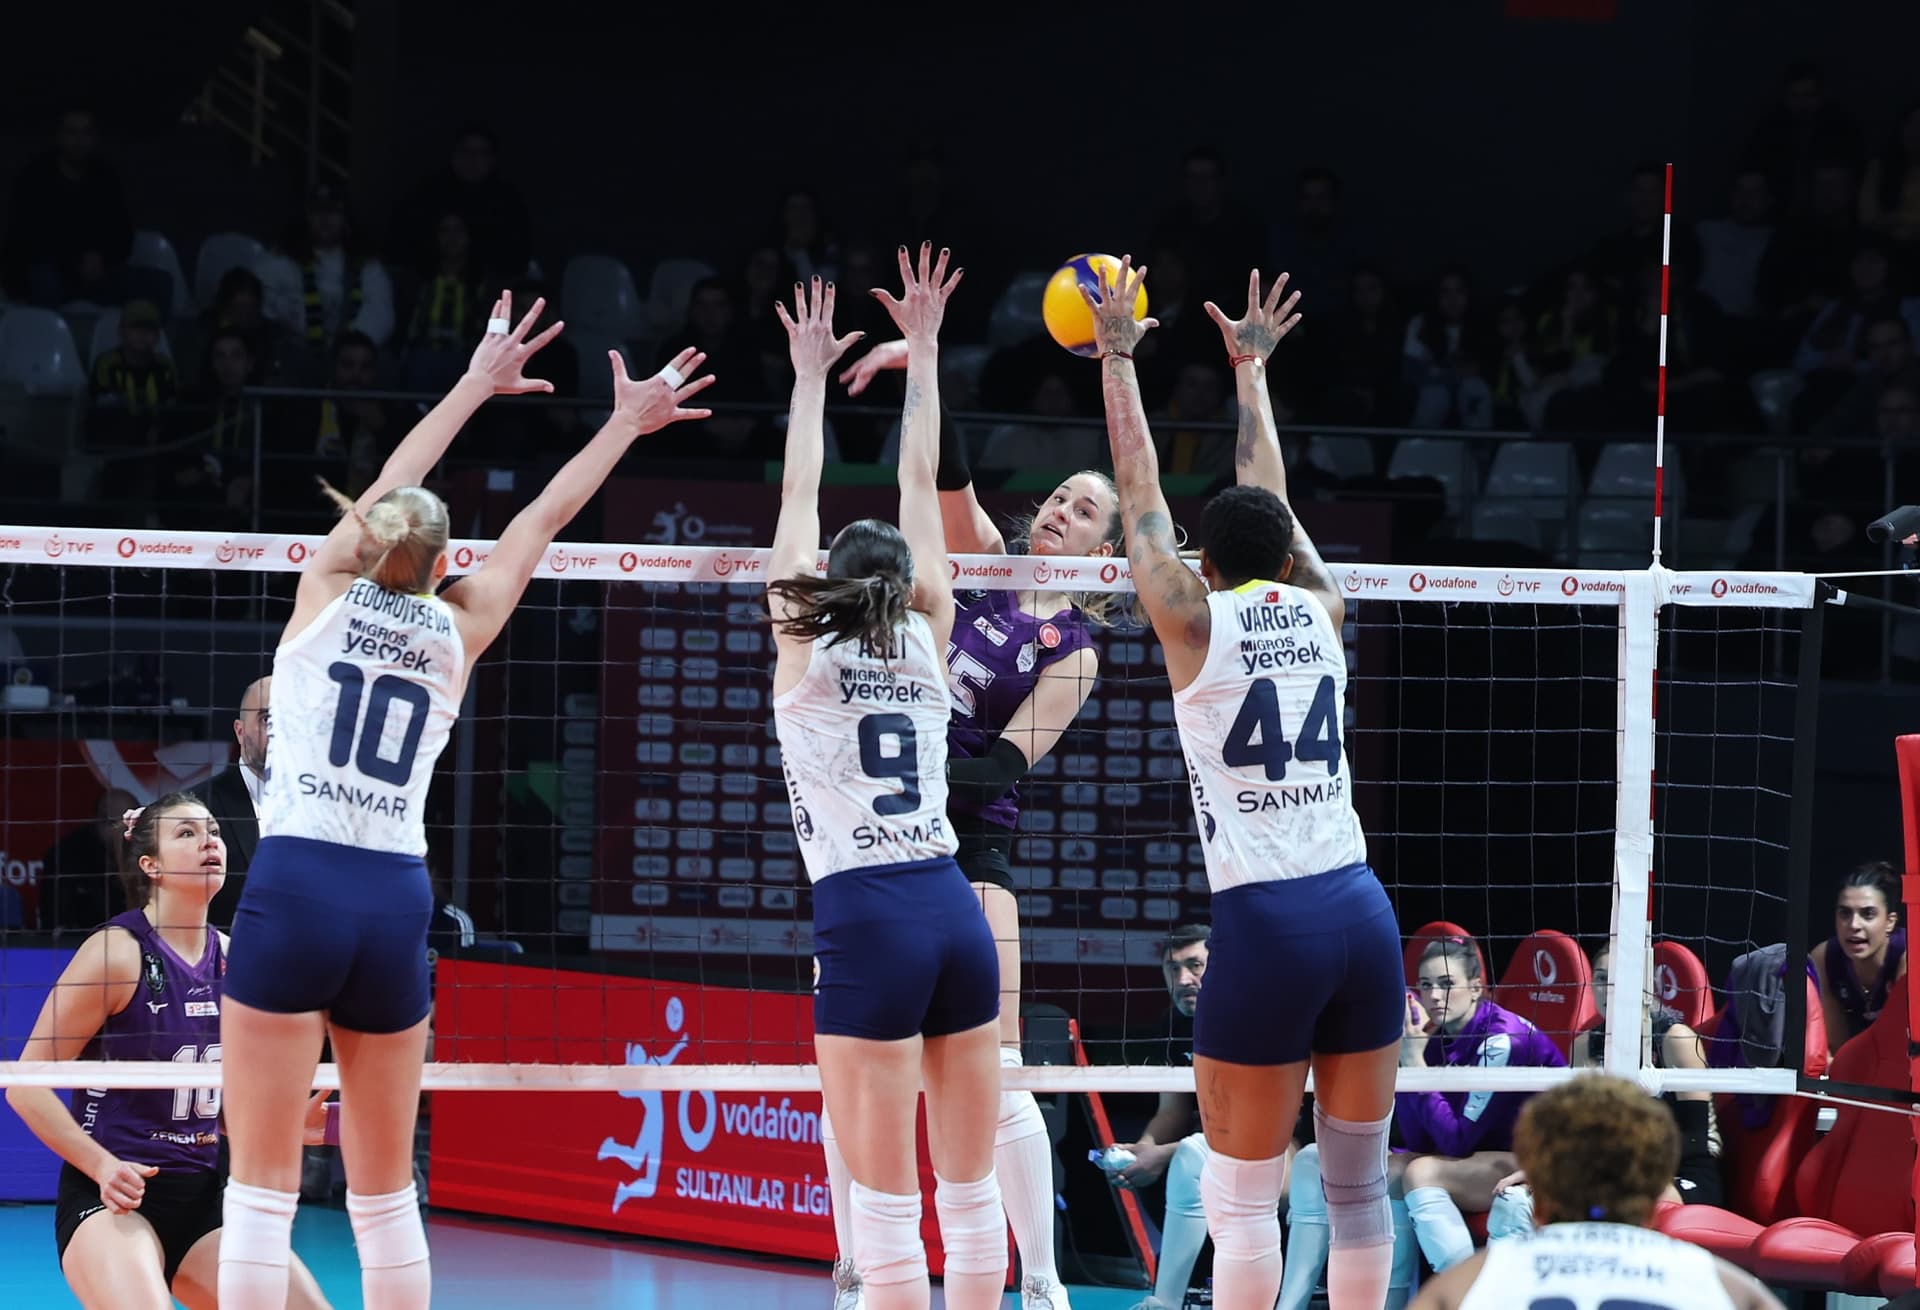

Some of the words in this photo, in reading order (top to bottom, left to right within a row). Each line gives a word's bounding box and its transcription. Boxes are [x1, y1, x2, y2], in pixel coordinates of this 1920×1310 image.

[67, 543, 94, 553] TVF
[138, 542, 193, 555] vodafone
[238, 548, 264, 559] TVF
[571, 557, 598, 569] TVF
[640, 556, 692, 568] vodafone
[734, 560, 760, 572] TVF
[962, 565, 1013, 577] vodafone
[1054, 569, 1080, 580] TVF
[1364, 578, 1389, 590] TVF
[1429, 577, 1477, 589] vodafone
[1517, 581, 1541, 593] TVF
[1581, 580, 1625, 593] vodafon
[1730, 583, 1778, 595] vodafone
[1239, 604, 1313, 633] VARGAS
[342, 631, 432, 674] yemek
[1241, 643, 1324, 676] yemek
[840, 680, 923, 704] yemek
[328, 660, 431, 788] 10
[1222, 675, 1342, 782] 44
[857, 712, 923, 817] 9
[298, 773, 408, 822] SANMAR
[1236, 778, 1343, 813] SANMAR
[675, 1167, 785, 1211] SULTANLAR
